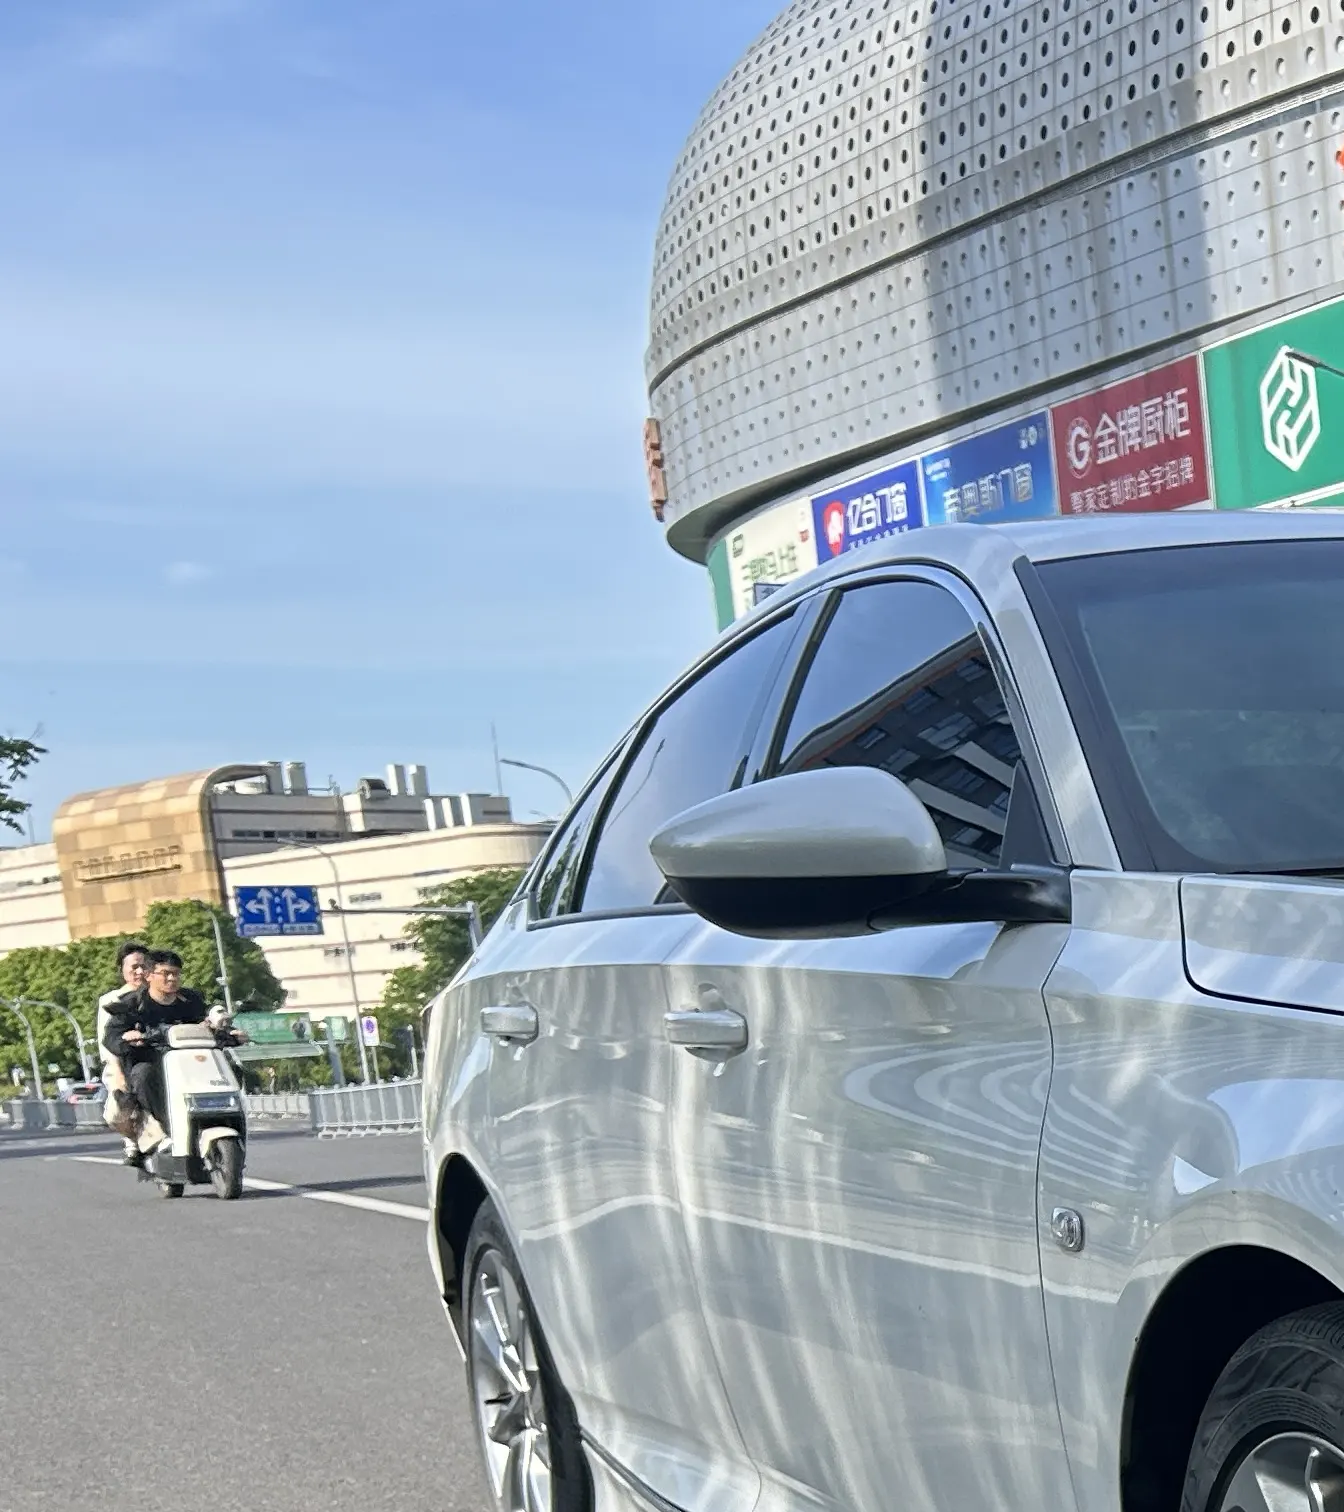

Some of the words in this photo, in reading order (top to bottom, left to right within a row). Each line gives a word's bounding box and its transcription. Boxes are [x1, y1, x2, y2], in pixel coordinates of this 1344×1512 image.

[1094, 386, 1192, 465] 金牌厨柜
[846, 482, 908, 535] 亿合门窗
[1070, 455, 1195, 513] 整家定制的金字招牌
